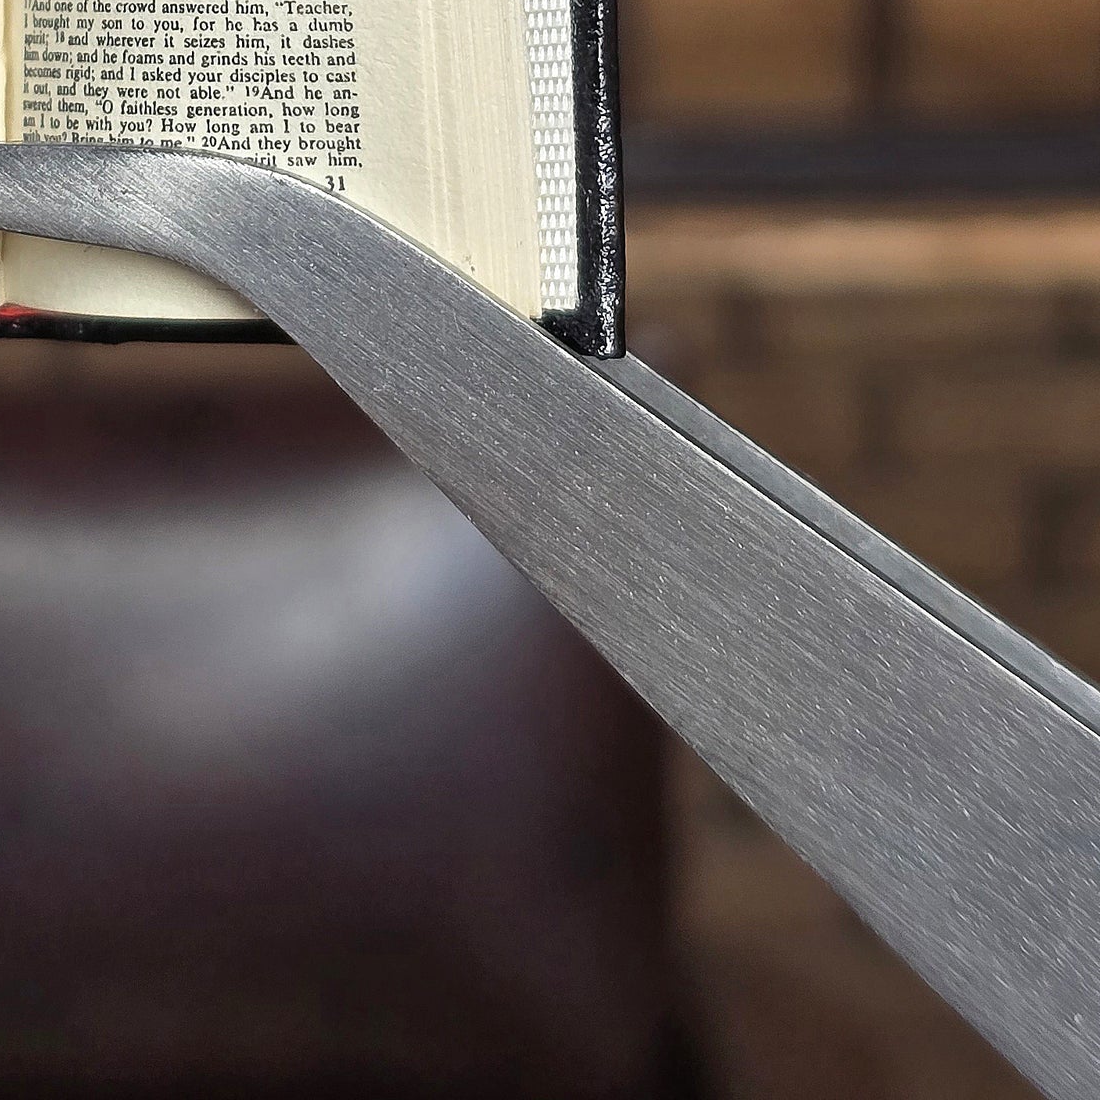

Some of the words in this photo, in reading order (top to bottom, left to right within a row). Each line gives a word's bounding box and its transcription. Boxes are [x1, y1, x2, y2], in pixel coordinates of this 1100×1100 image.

[65, 65, 96, 83] rigid;
[100, 66, 124, 81] and
[129, 67, 135, 81] I
[141, 67, 182, 82] asked
[187, 71, 223, 86] your
[229, 68, 296, 86] disciples
[302, 70, 319, 82] to
[325, 69, 357, 82] cast
[287, 156, 317, 167] saw
[328, 152, 363, 168] him,
[325, 175, 346, 192] 31
